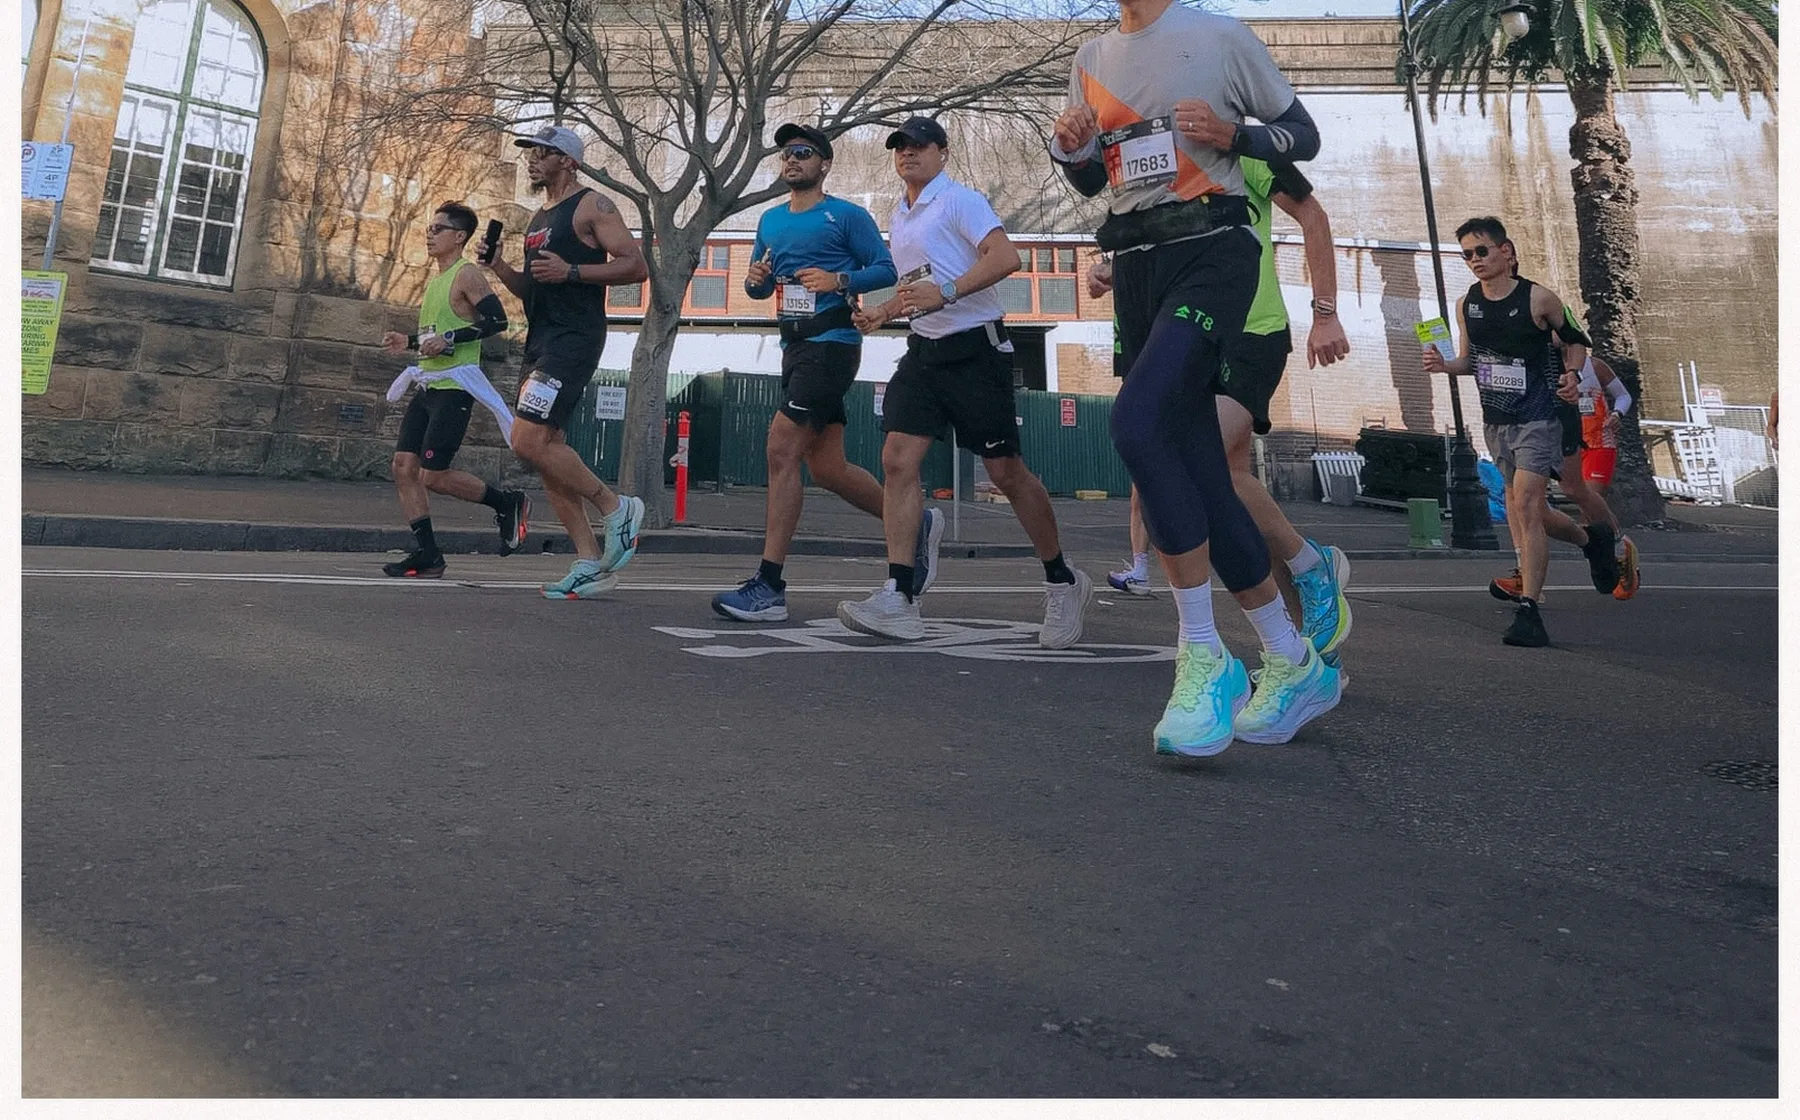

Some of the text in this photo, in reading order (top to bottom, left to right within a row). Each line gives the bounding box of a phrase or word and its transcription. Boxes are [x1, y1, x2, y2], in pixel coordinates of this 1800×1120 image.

[1126, 153, 1169, 177] 17683
[1194, 309, 1214, 331] T8
[21, 332, 46, 340] URING
[21, 339, 51, 347] ARWAY
[1492, 375, 1524, 387] 20289
